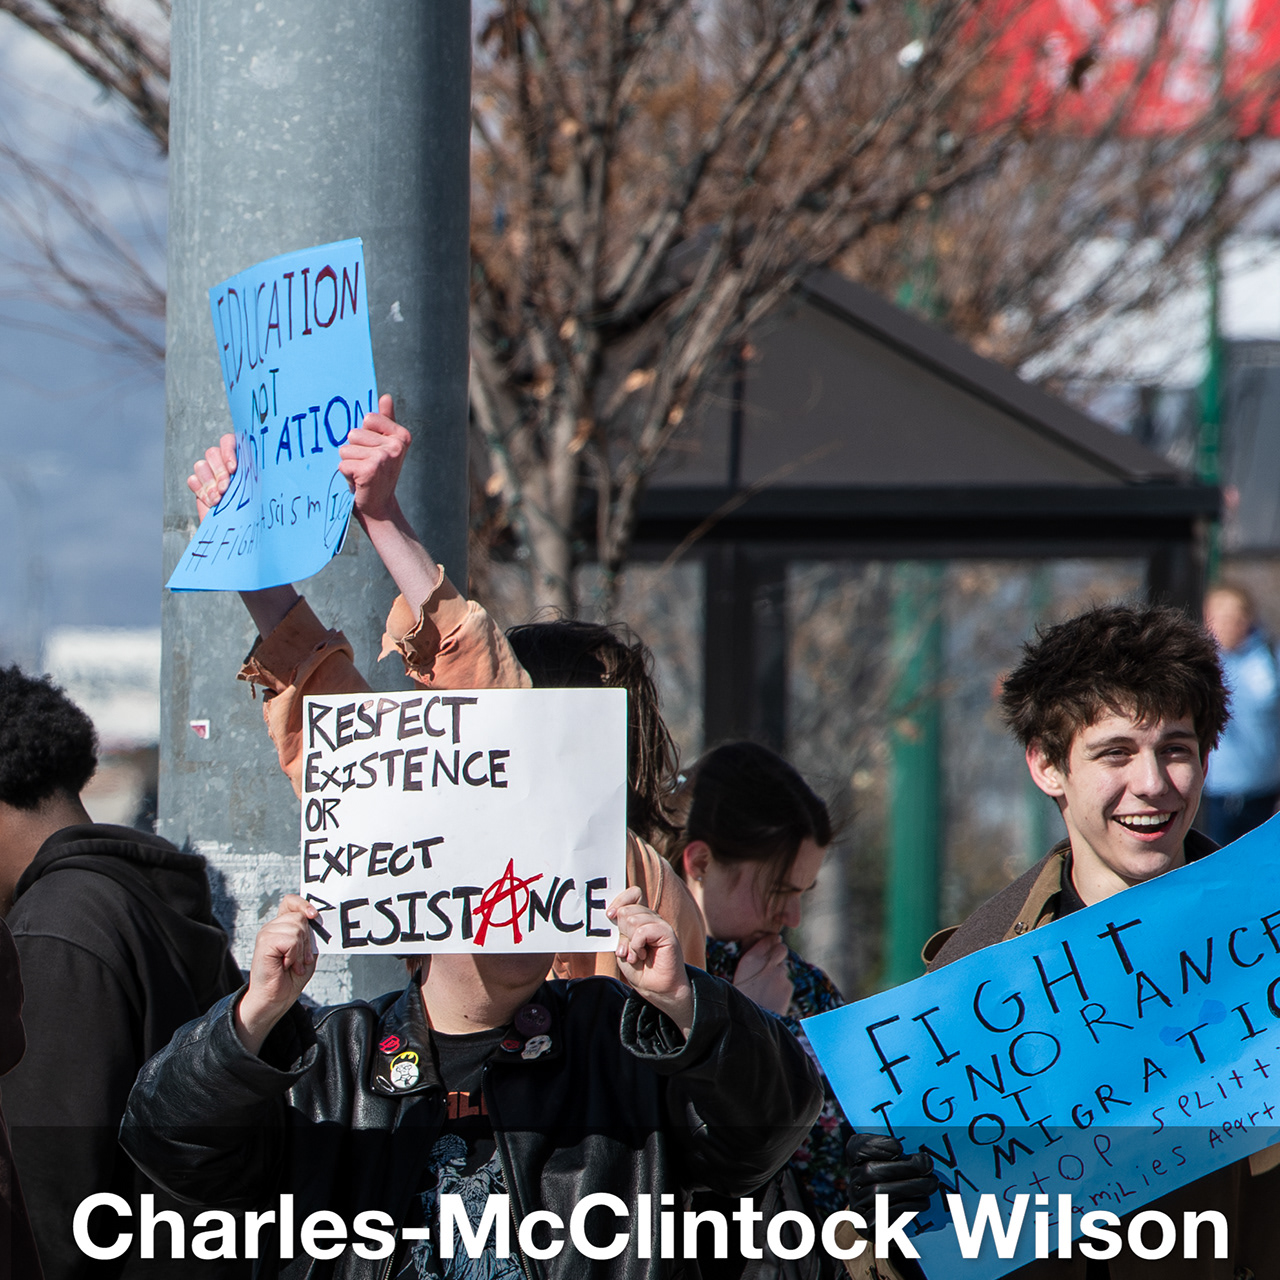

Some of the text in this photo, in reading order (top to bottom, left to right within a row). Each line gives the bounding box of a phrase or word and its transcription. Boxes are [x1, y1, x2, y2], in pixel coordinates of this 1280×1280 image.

[217, 261, 359, 392] EDUCATION
[251, 367, 280, 434] NOT
[308, 696, 479, 752] RESPECT
[305, 746, 511, 793] EXISTENCE
[305, 797, 341, 832] OR
[303, 836, 445, 884] EXPECT
[306, 857, 612, 949] RESISTANCE
[865, 917, 1142, 1096] FIGHT
[871, 911, 1280, 1142] IGNORANCE
[919, 1085, 1033, 1169] NOT
